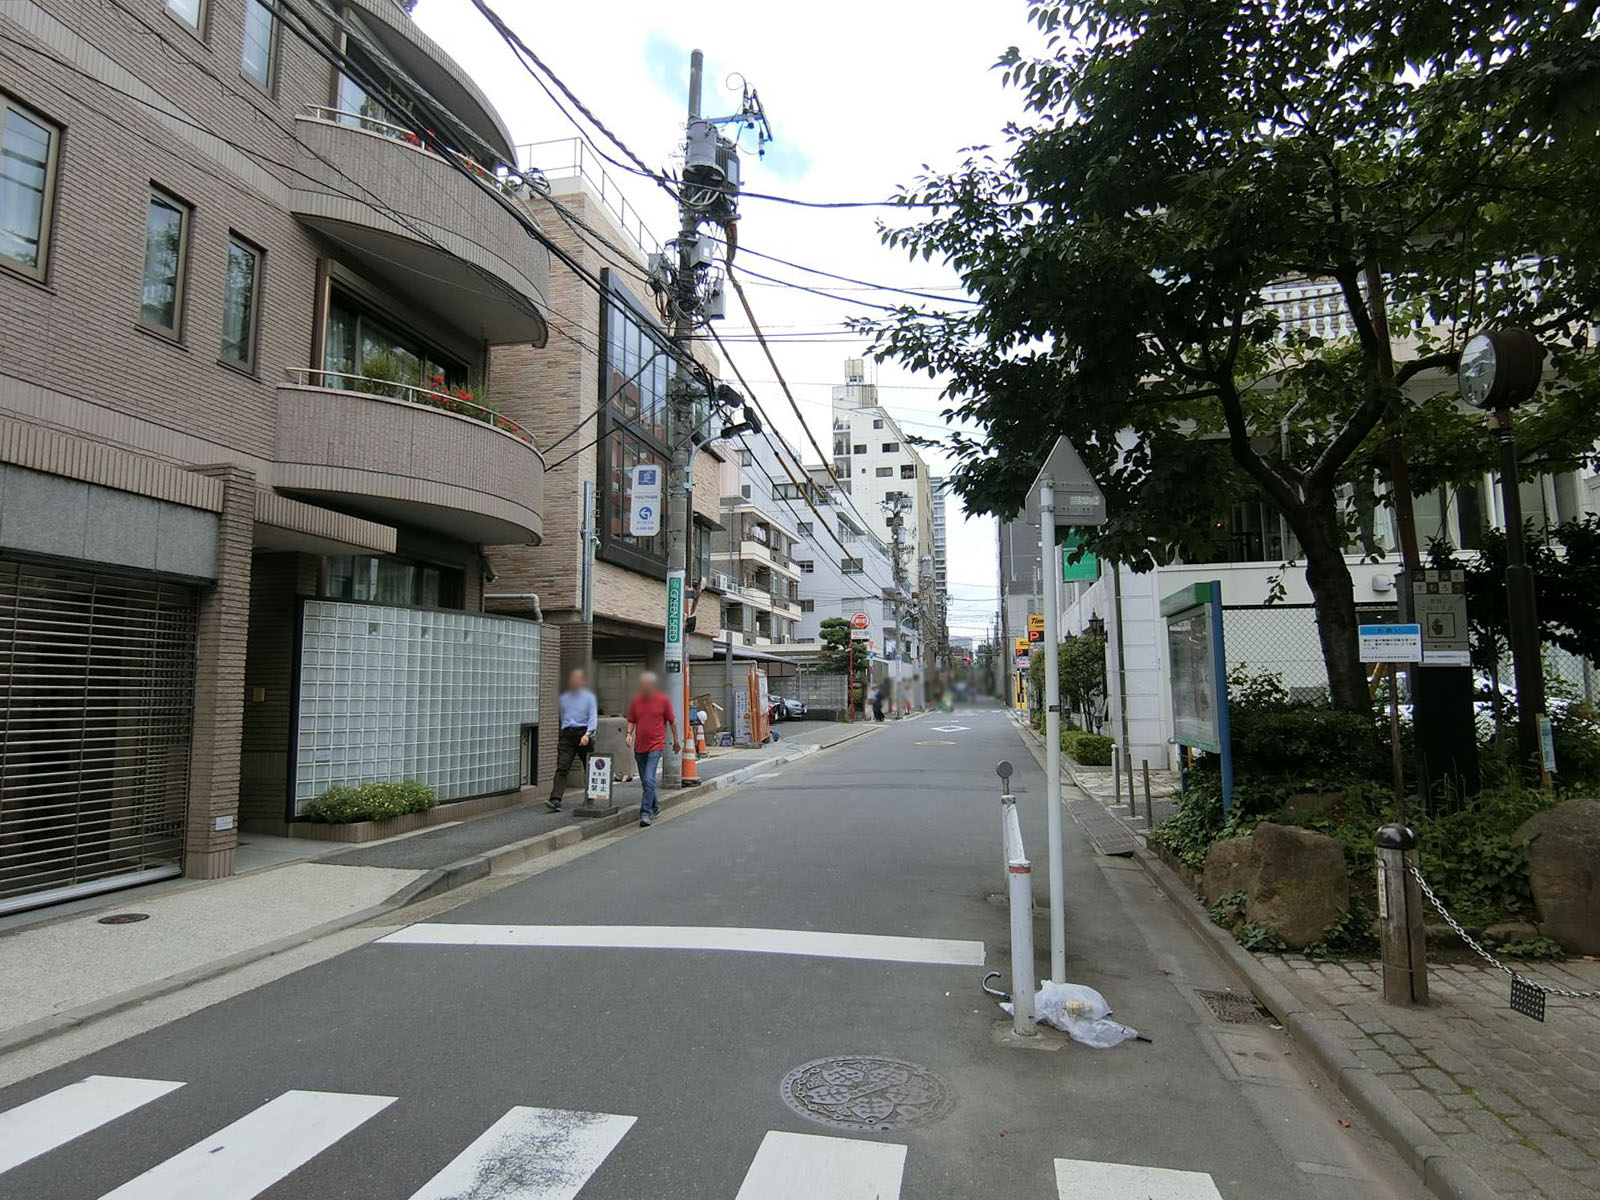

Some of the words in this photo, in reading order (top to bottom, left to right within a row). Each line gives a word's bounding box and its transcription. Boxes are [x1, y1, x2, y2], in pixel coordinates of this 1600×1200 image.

[669, 589, 679, 618] GREEN
[668, 618, 678, 641] SEED
[1030, 632, 1039, 641] P
